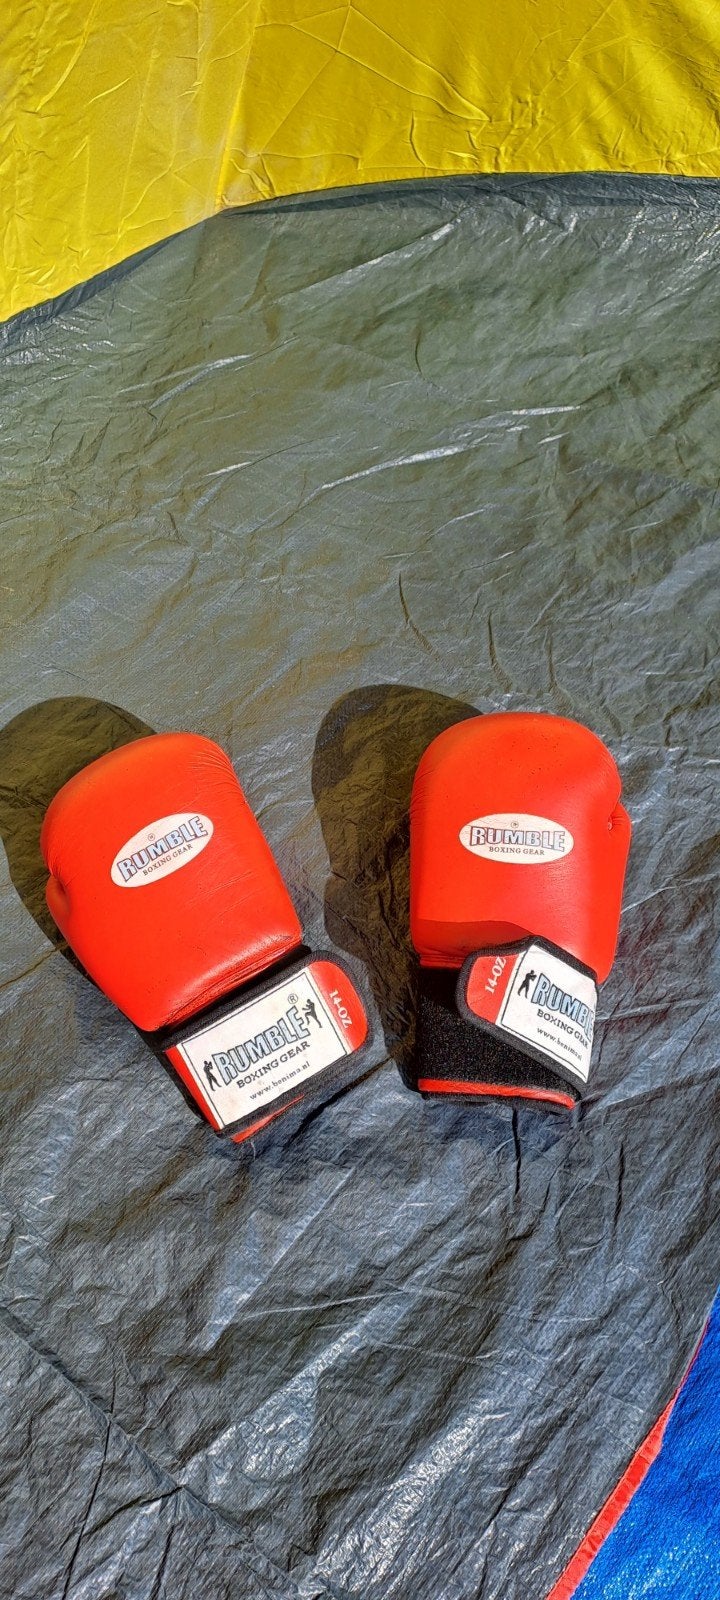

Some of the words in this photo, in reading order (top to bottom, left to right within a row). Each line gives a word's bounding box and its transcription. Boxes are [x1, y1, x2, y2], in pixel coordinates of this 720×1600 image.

[117, 816, 208, 882] RUMBLE
[469, 826, 566, 852] RUMBLE
[489, 846, 521, 854] BOXING
[143, 856, 172, 876] BOXING
[172, 843, 193, 858] GEAR
[484, 956, 507, 994] 14-OZ
[329, 989, 352, 1029] 14-OZ
[536, 1008, 574, 1035] BOXING
[211, 1005, 311, 1085] RUMBLE
[236, 1058, 280, 1088] BOXING
[279, 1041, 311, 1064] GEAR
[249, 1061, 311, 1101] www.benima.nl
